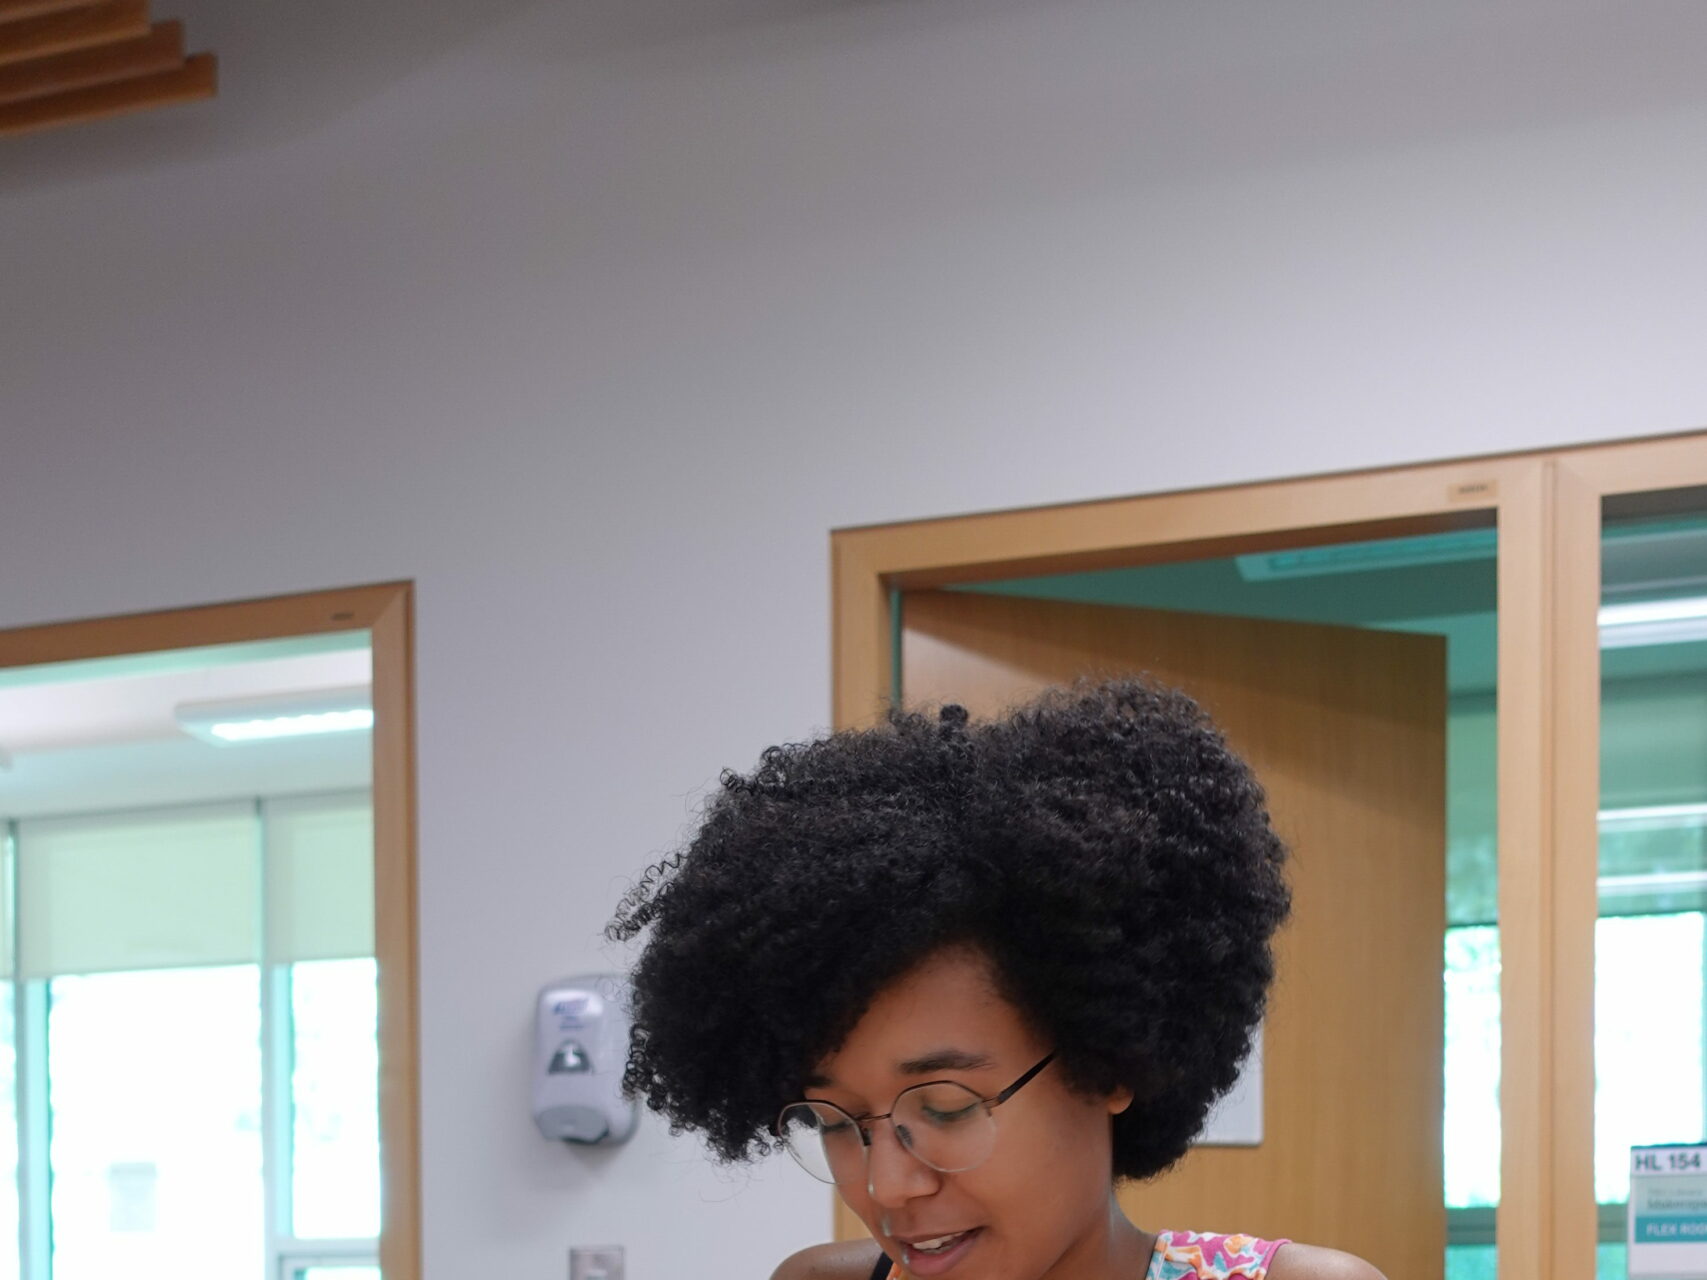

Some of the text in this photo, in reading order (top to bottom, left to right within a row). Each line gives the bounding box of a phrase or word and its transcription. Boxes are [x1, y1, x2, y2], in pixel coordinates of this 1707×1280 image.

[1635, 1153, 1700, 1171] HL 154
[1680, 1222, 1707, 1236] ROO
